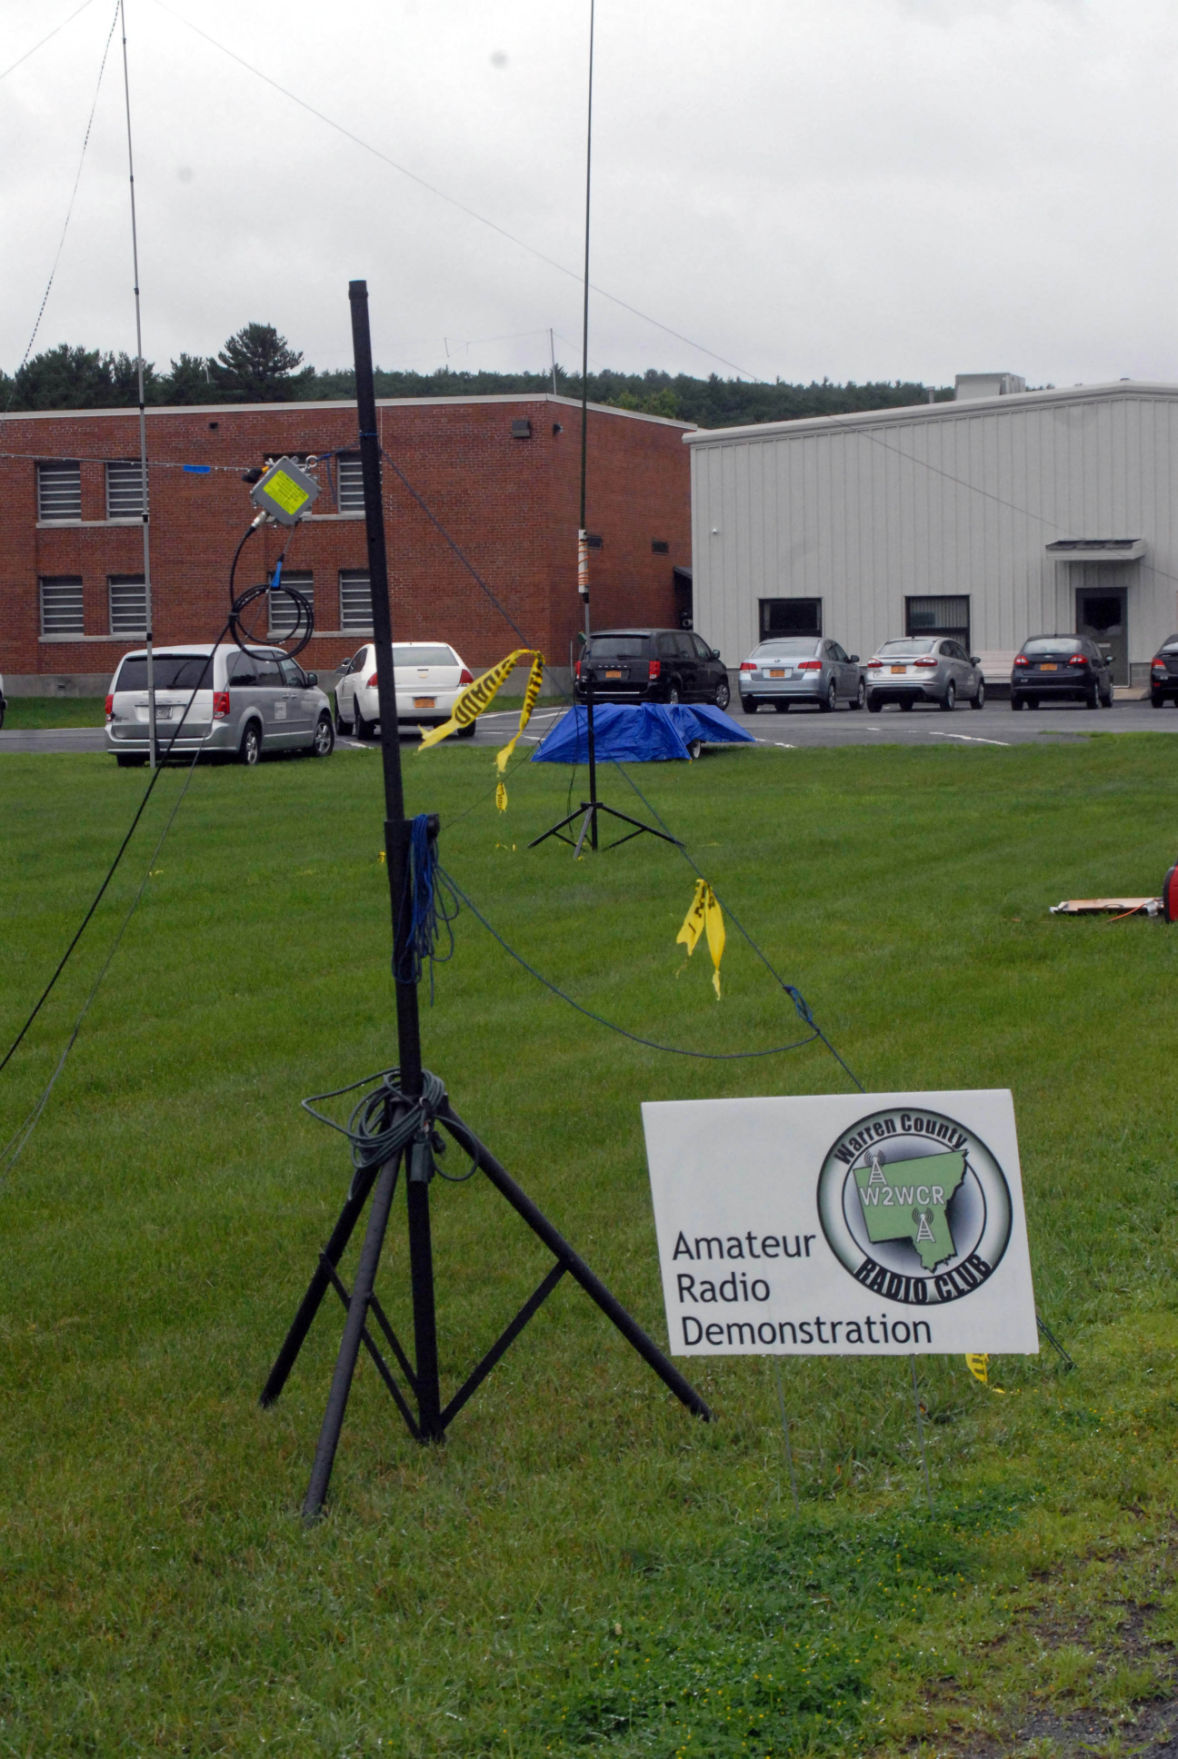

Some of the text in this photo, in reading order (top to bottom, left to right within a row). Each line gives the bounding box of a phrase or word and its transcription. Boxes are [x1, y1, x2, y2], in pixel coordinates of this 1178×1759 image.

[834, 1113, 968, 1166] Warren County
[859, 1185, 945, 1206] W2WCR
[672, 1230, 817, 1260] Amateur
[676, 1271, 771, 1304] Radio
[853, 1253, 992, 1304] RADIO CLUB
[681, 1313, 933, 1346] Demonstration
